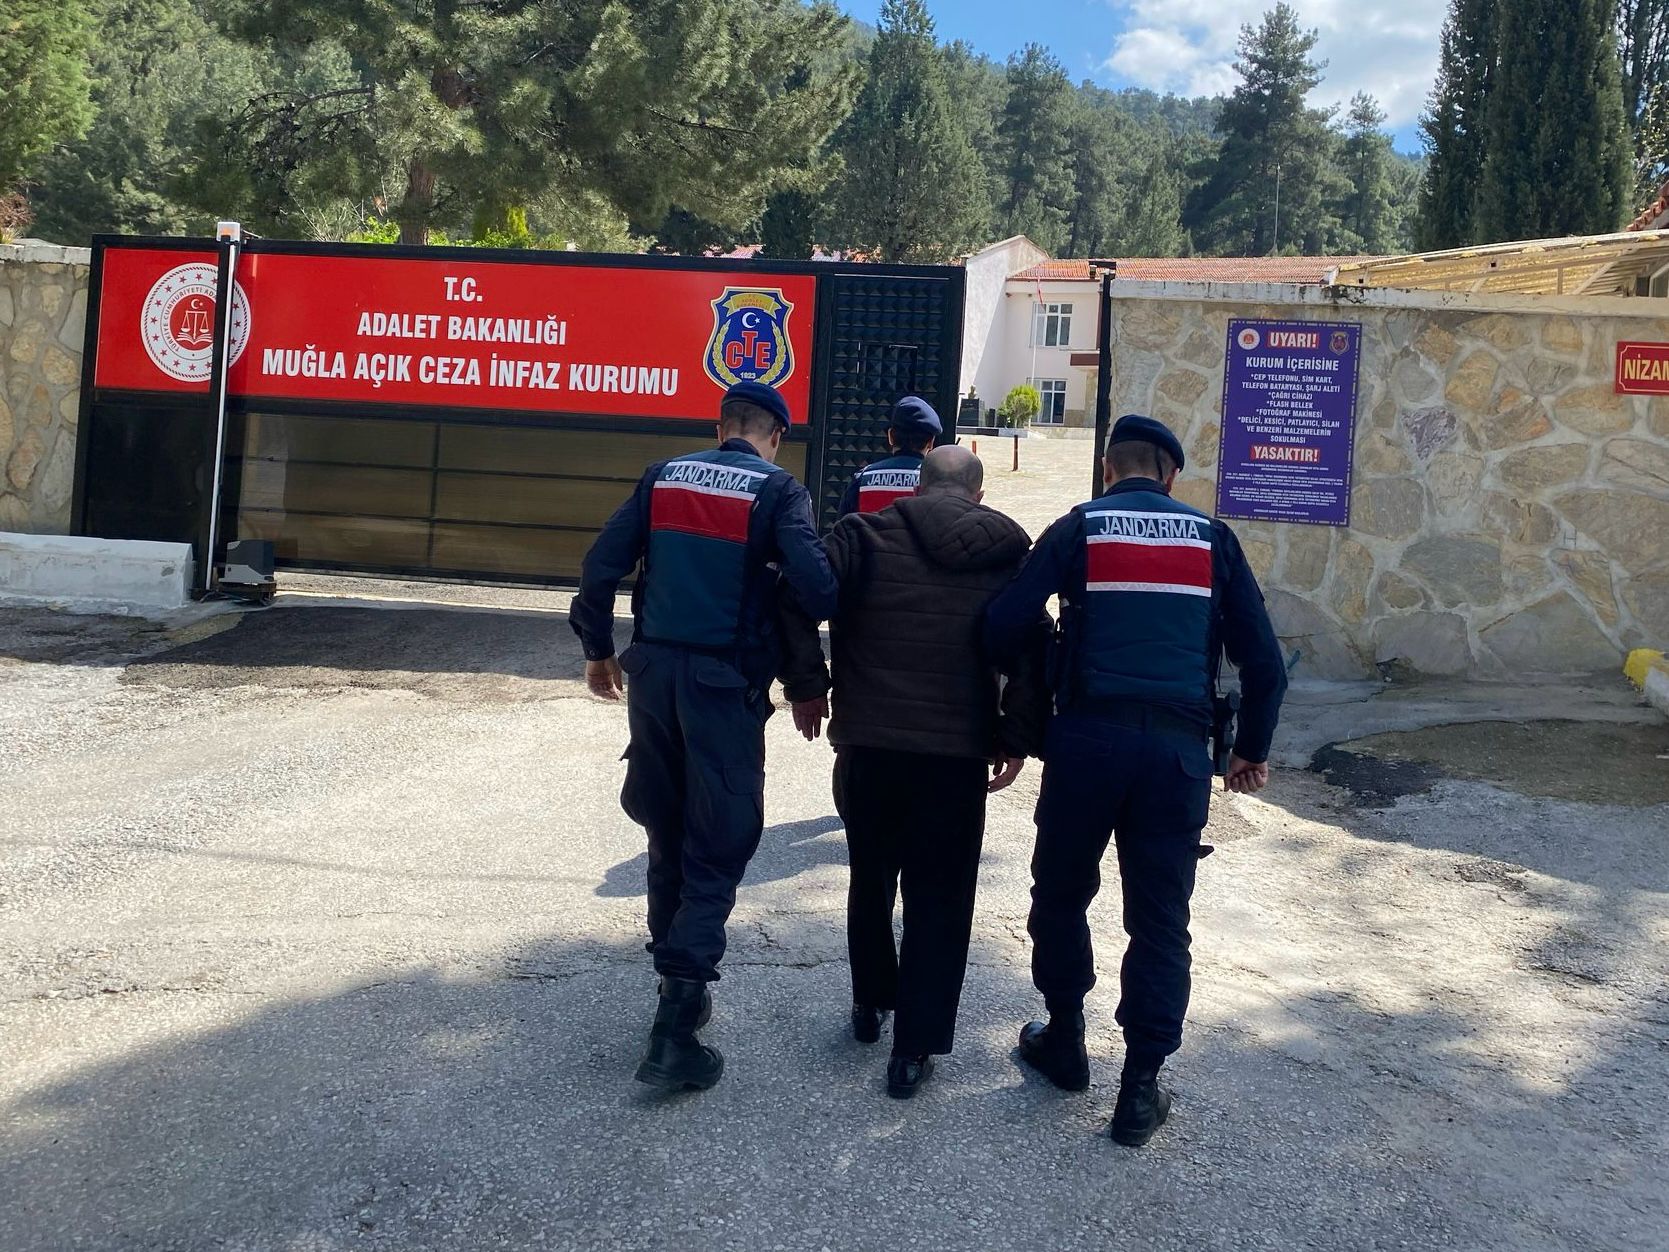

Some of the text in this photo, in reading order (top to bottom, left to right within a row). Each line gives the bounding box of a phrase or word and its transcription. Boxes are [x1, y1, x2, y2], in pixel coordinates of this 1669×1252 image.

[443, 276, 483, 302] T.C.
[357, 312, 566, 345] ADALET BAKANLIĞI
[1269, 332, 1317, 348] UYARI!
[262, 344, 679, 396] MUĞLA AÇIK CEZA İNFAZ KURUMU
[1246, 356, 1339, 371] KURUM İÇERİSİNE
[1270, 435, 1306, 444] SOKULMASI
[1253, 446, 1318, 462] YASAKTIR!
[665, 464, 751, 492] JANDARMA
[866, 472, 920, 487] JANDARM
[1099, 515, 1201, 539] JANDARMA
